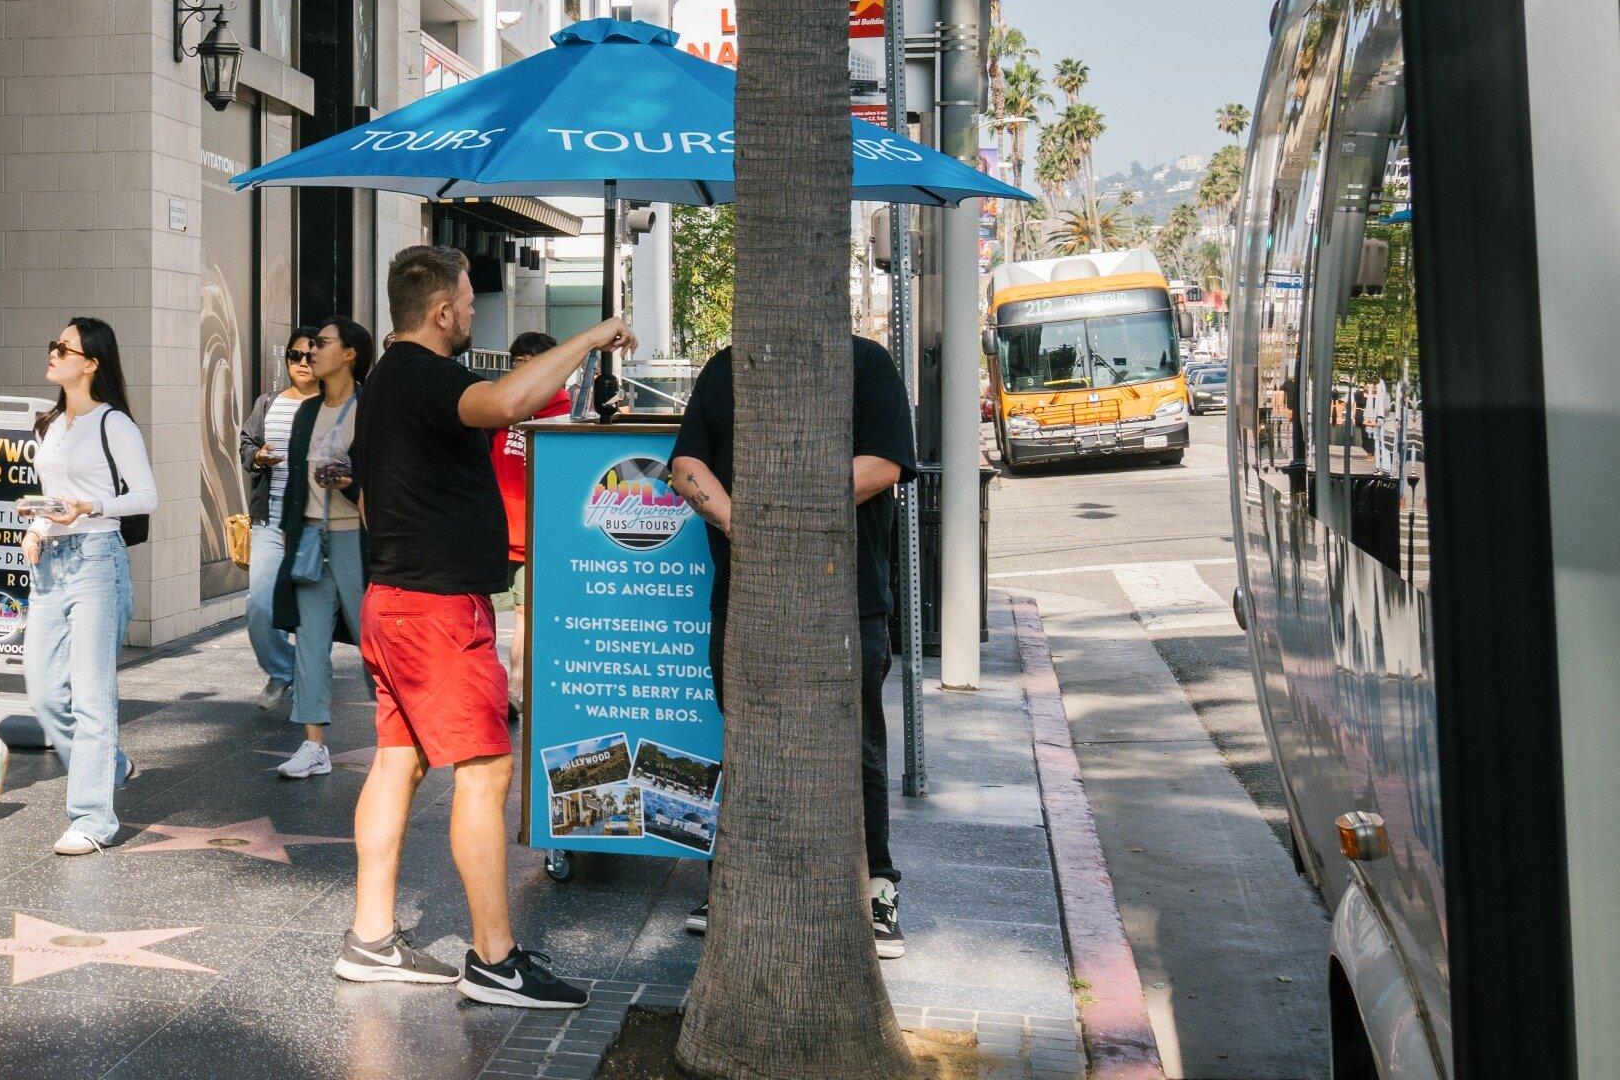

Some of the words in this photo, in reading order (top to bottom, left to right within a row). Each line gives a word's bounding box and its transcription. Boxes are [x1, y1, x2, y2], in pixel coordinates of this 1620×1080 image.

[721, 8, 736, 34] L
[861, 18, 886, 26] Buildin
[686, 42, 738, 67] NA
[349, 126, 507, 153] TOURS
[853, 133, 924, 163] URS
[8, 465, 39, 485] CEN
[586, 488, 692, 529] Hollywood
[605, 519, 627, 530] BUS
[639, 520, 677, 531] TOURS
[5, 550, 25, 565] DR
[570, 559, 628, 573] THINGS
[634, 561, 654, 574] TO
[659, 562, 684, 574] DO
[689, 563, 706, 575] IN
[7, 572, 29, 587] RO
[586, 582, 616, 595] LOS
[622, 583, 694, 597] ANGELES
[565, 617, 668, 633] SIGHTSEEING
[595, 640, 695, 656] DISNEYLAND
[565, 661, 651, 676] UNIVERSAL
[657, 665, 712, 678] STUDIO
[562, 682, 627, 697] KNOTT'S
[632, 686, 680, 699] BERRY
[685, 688, 714, 701] FAR
[586, 705, 650, 720] WARNER
[655, 708, 703, 722] BROS.
[560, 751, 611, 772] HOLLYWOOD
